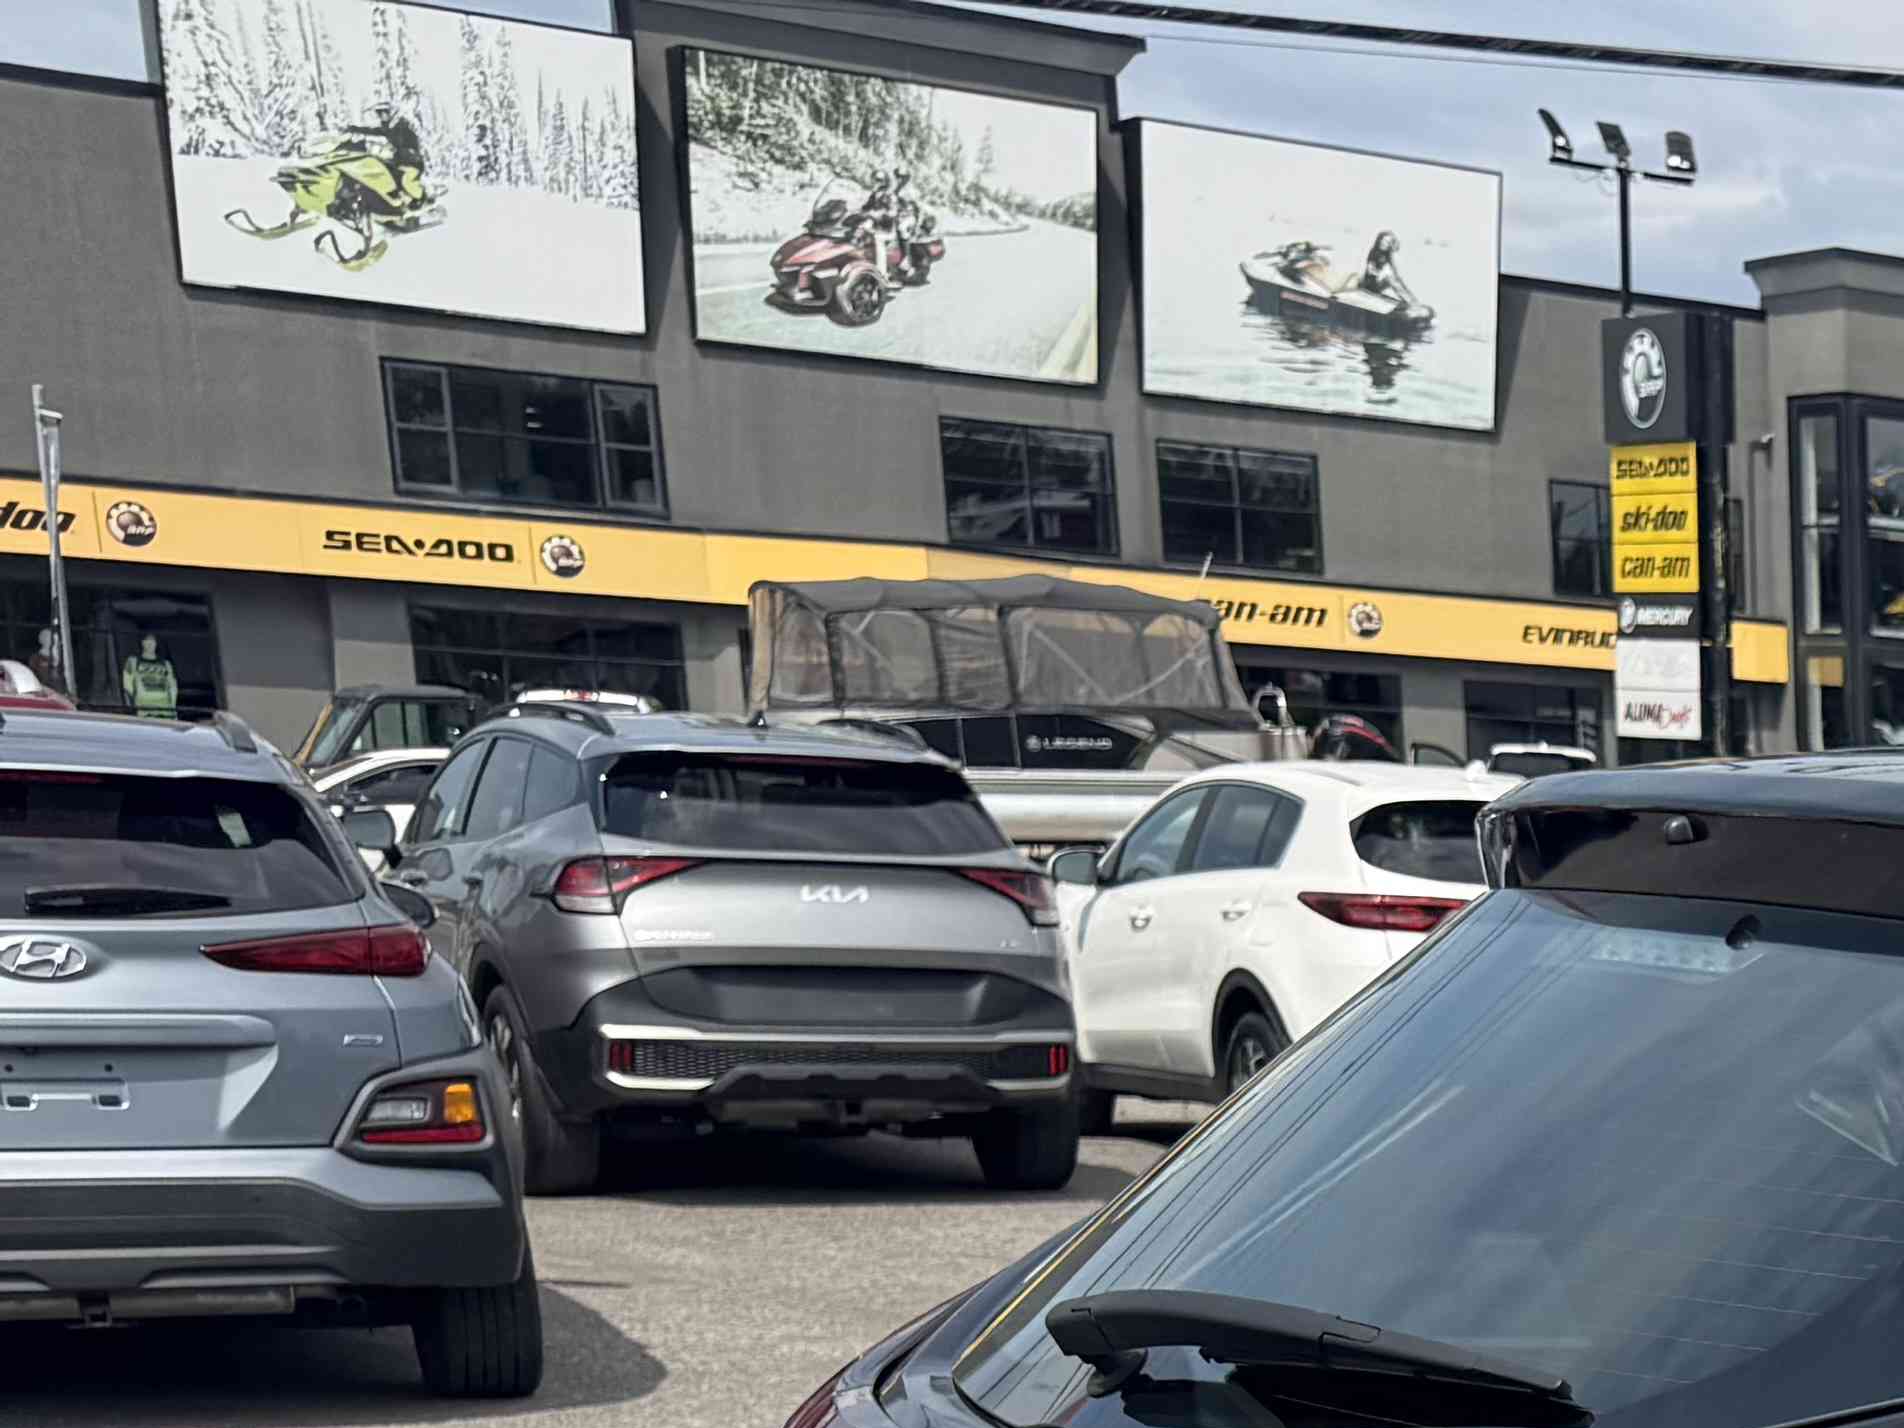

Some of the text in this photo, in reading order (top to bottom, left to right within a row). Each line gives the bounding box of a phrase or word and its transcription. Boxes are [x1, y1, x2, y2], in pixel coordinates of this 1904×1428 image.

[1620, 505, 1689, 532] ski-doo
[1621, 557, 1690, 579] can-am
[1195, 598, 1328, 628] an-am
[1636, 607, 1693, 625] MERCURY
[1522, 624, 1618, 650] EVINRUD
